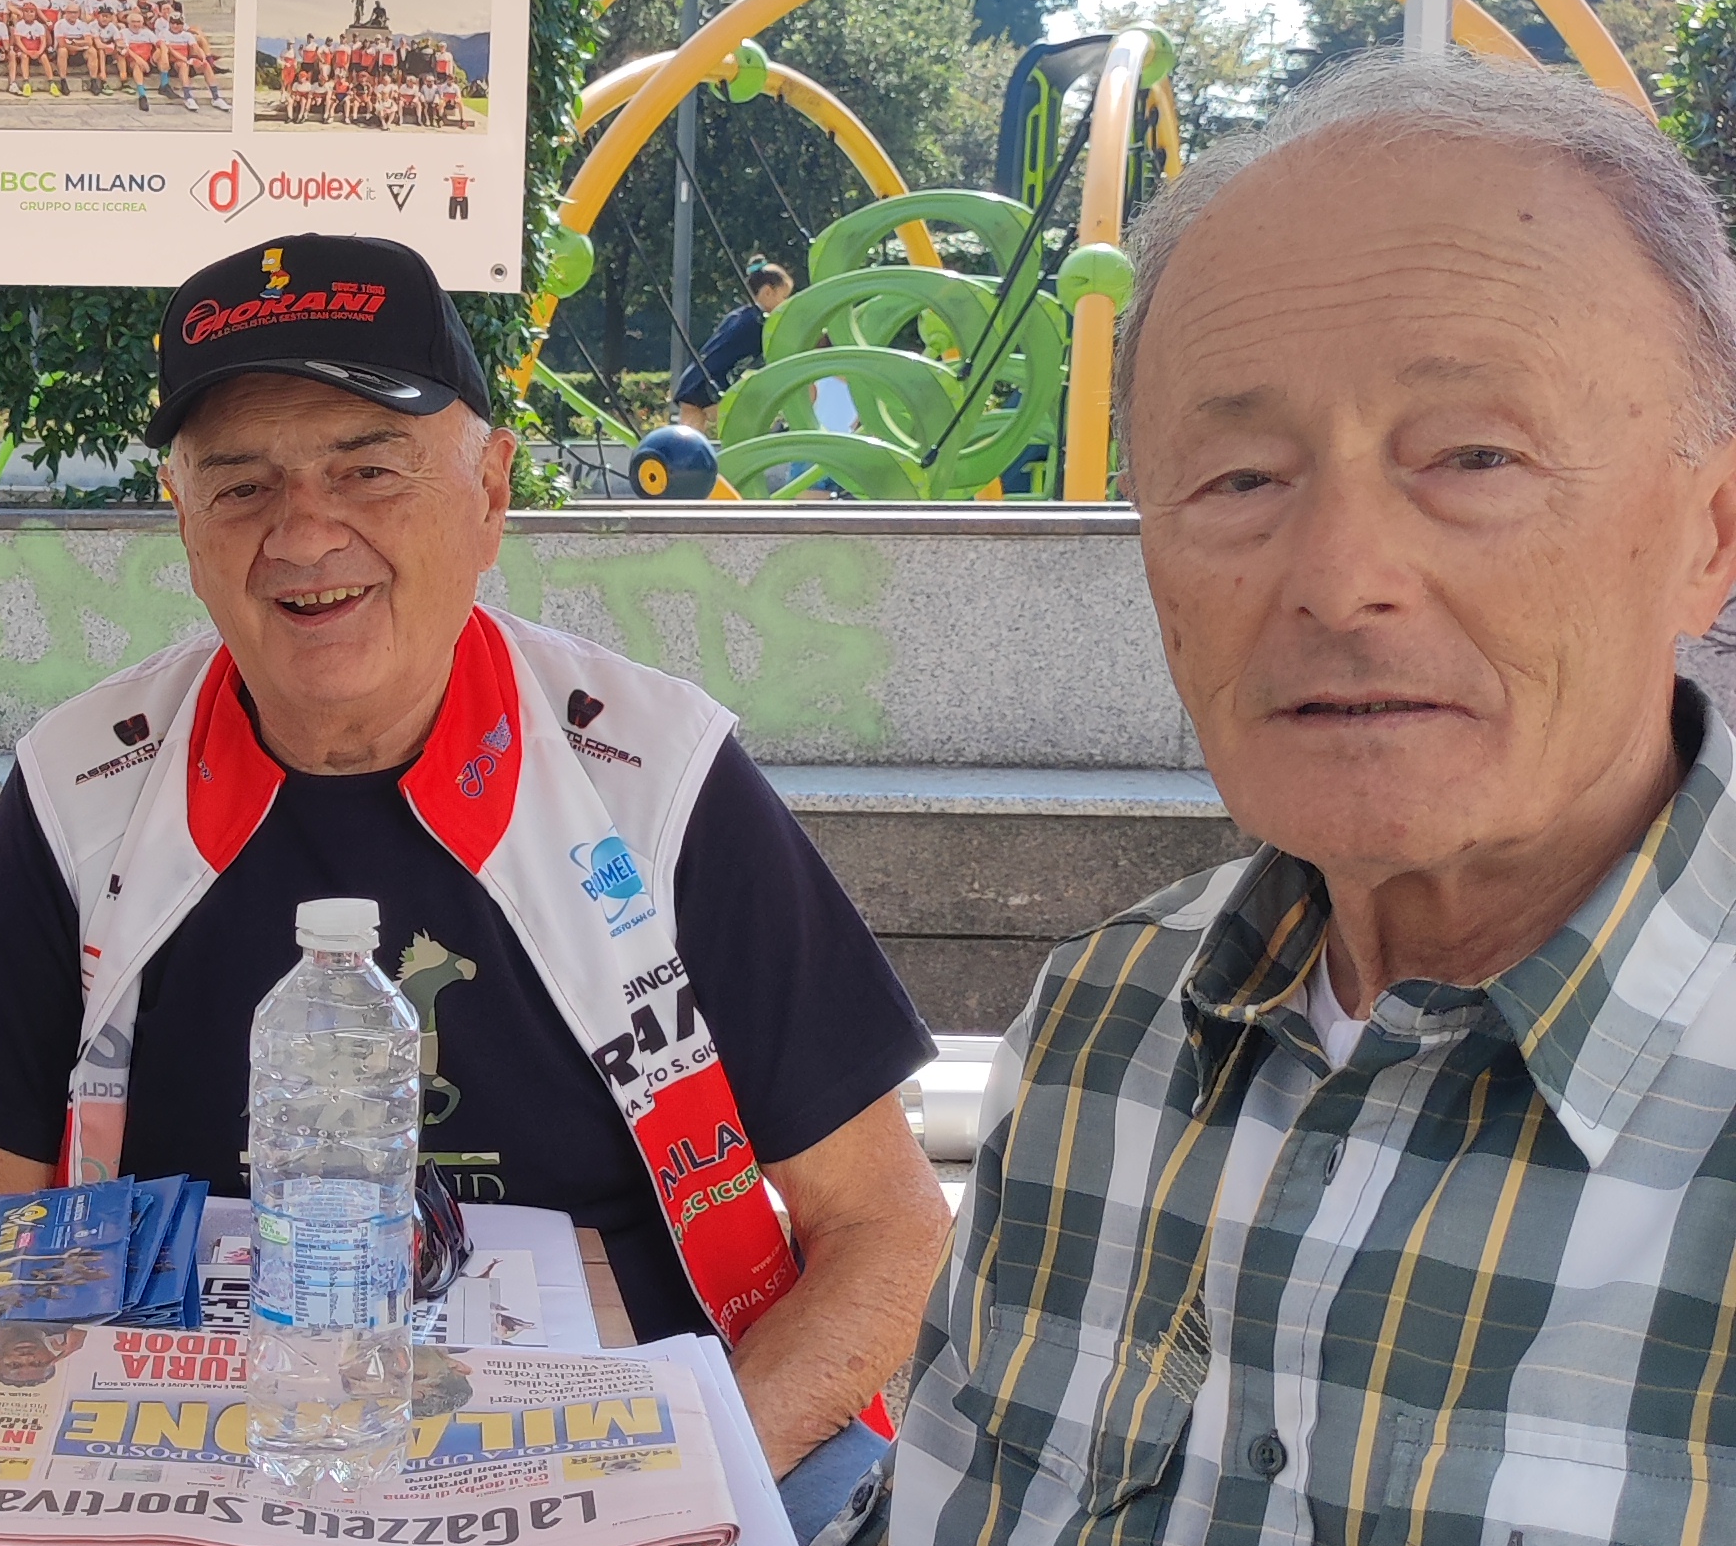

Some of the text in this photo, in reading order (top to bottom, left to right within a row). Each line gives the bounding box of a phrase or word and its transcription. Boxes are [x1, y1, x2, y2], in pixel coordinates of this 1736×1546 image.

[0, 171, 166, 193] BCC MILANO
[19, 201, 147, 213] GRUPPO BCC ICCREA
[75, 742, 155, 785] ASSETTO
[584, 736, 642, 769] CORSA
[122, 1354, 247, 1382] FURIA
[85, 1442, 189, 1461] POSTO
[261, 1502, 521, 1546] Gazzetta
[529, 1489, 596, 1531] La
